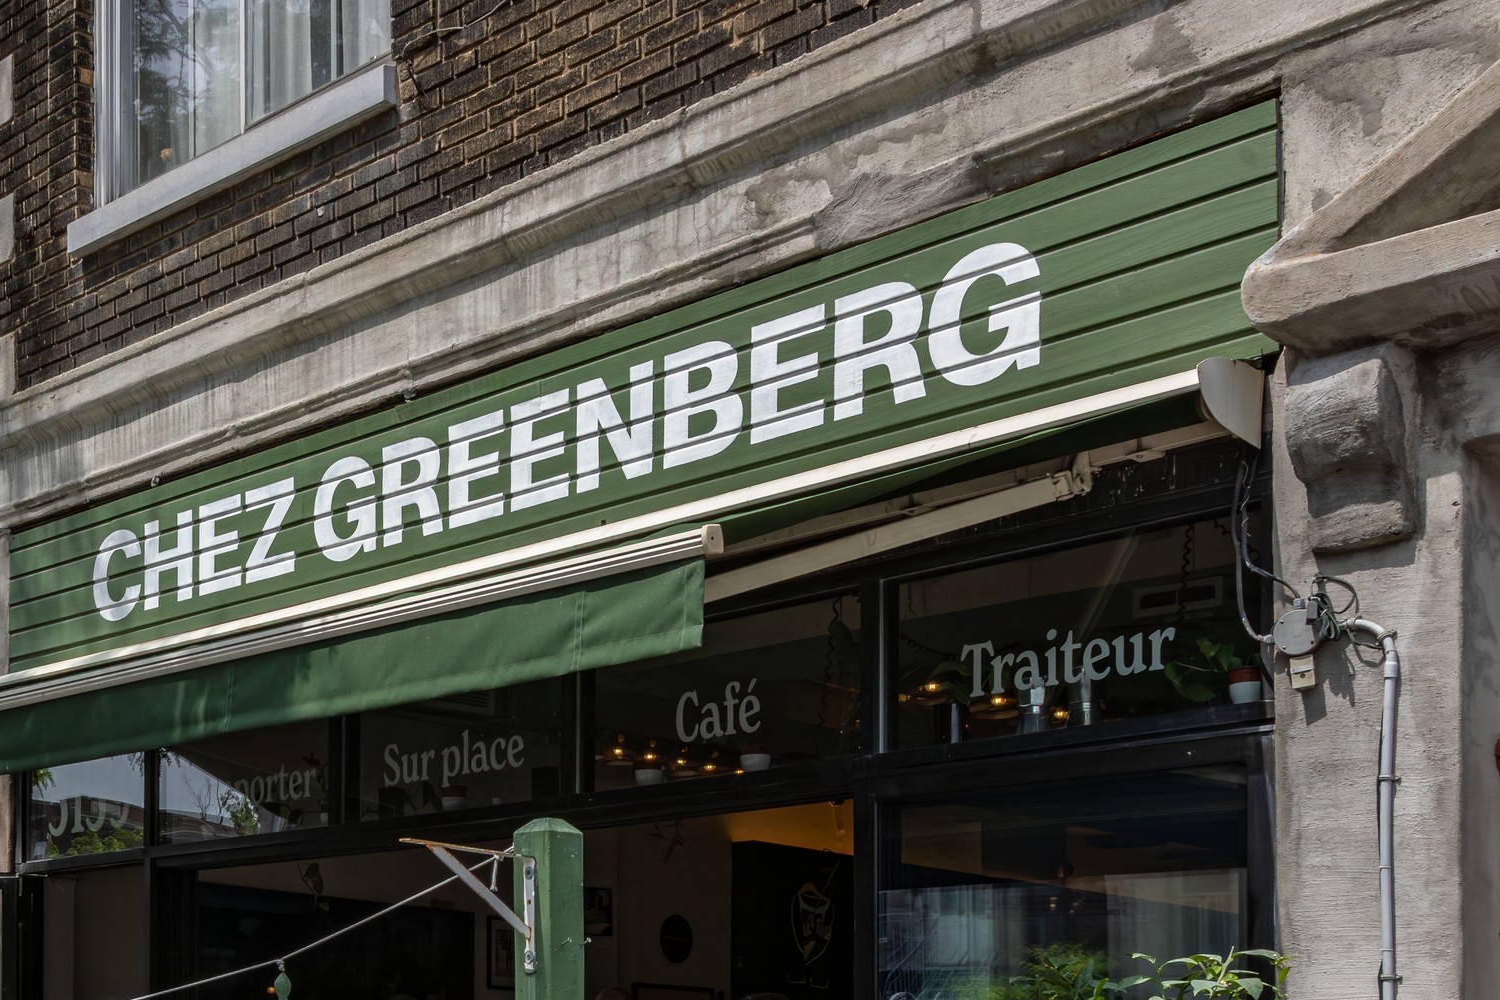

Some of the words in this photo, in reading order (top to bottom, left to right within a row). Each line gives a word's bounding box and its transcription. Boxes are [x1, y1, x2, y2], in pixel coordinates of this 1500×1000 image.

[91, 476, 297, 625] CHEZ
[313, 241, 1042, 563] GREENBERG
[960, 626, 1176, 699] Traiteur
[675, 678, 761, 744] Café
[383, 743, 436, 787] Sur
[440, 728, 525, 788] place
